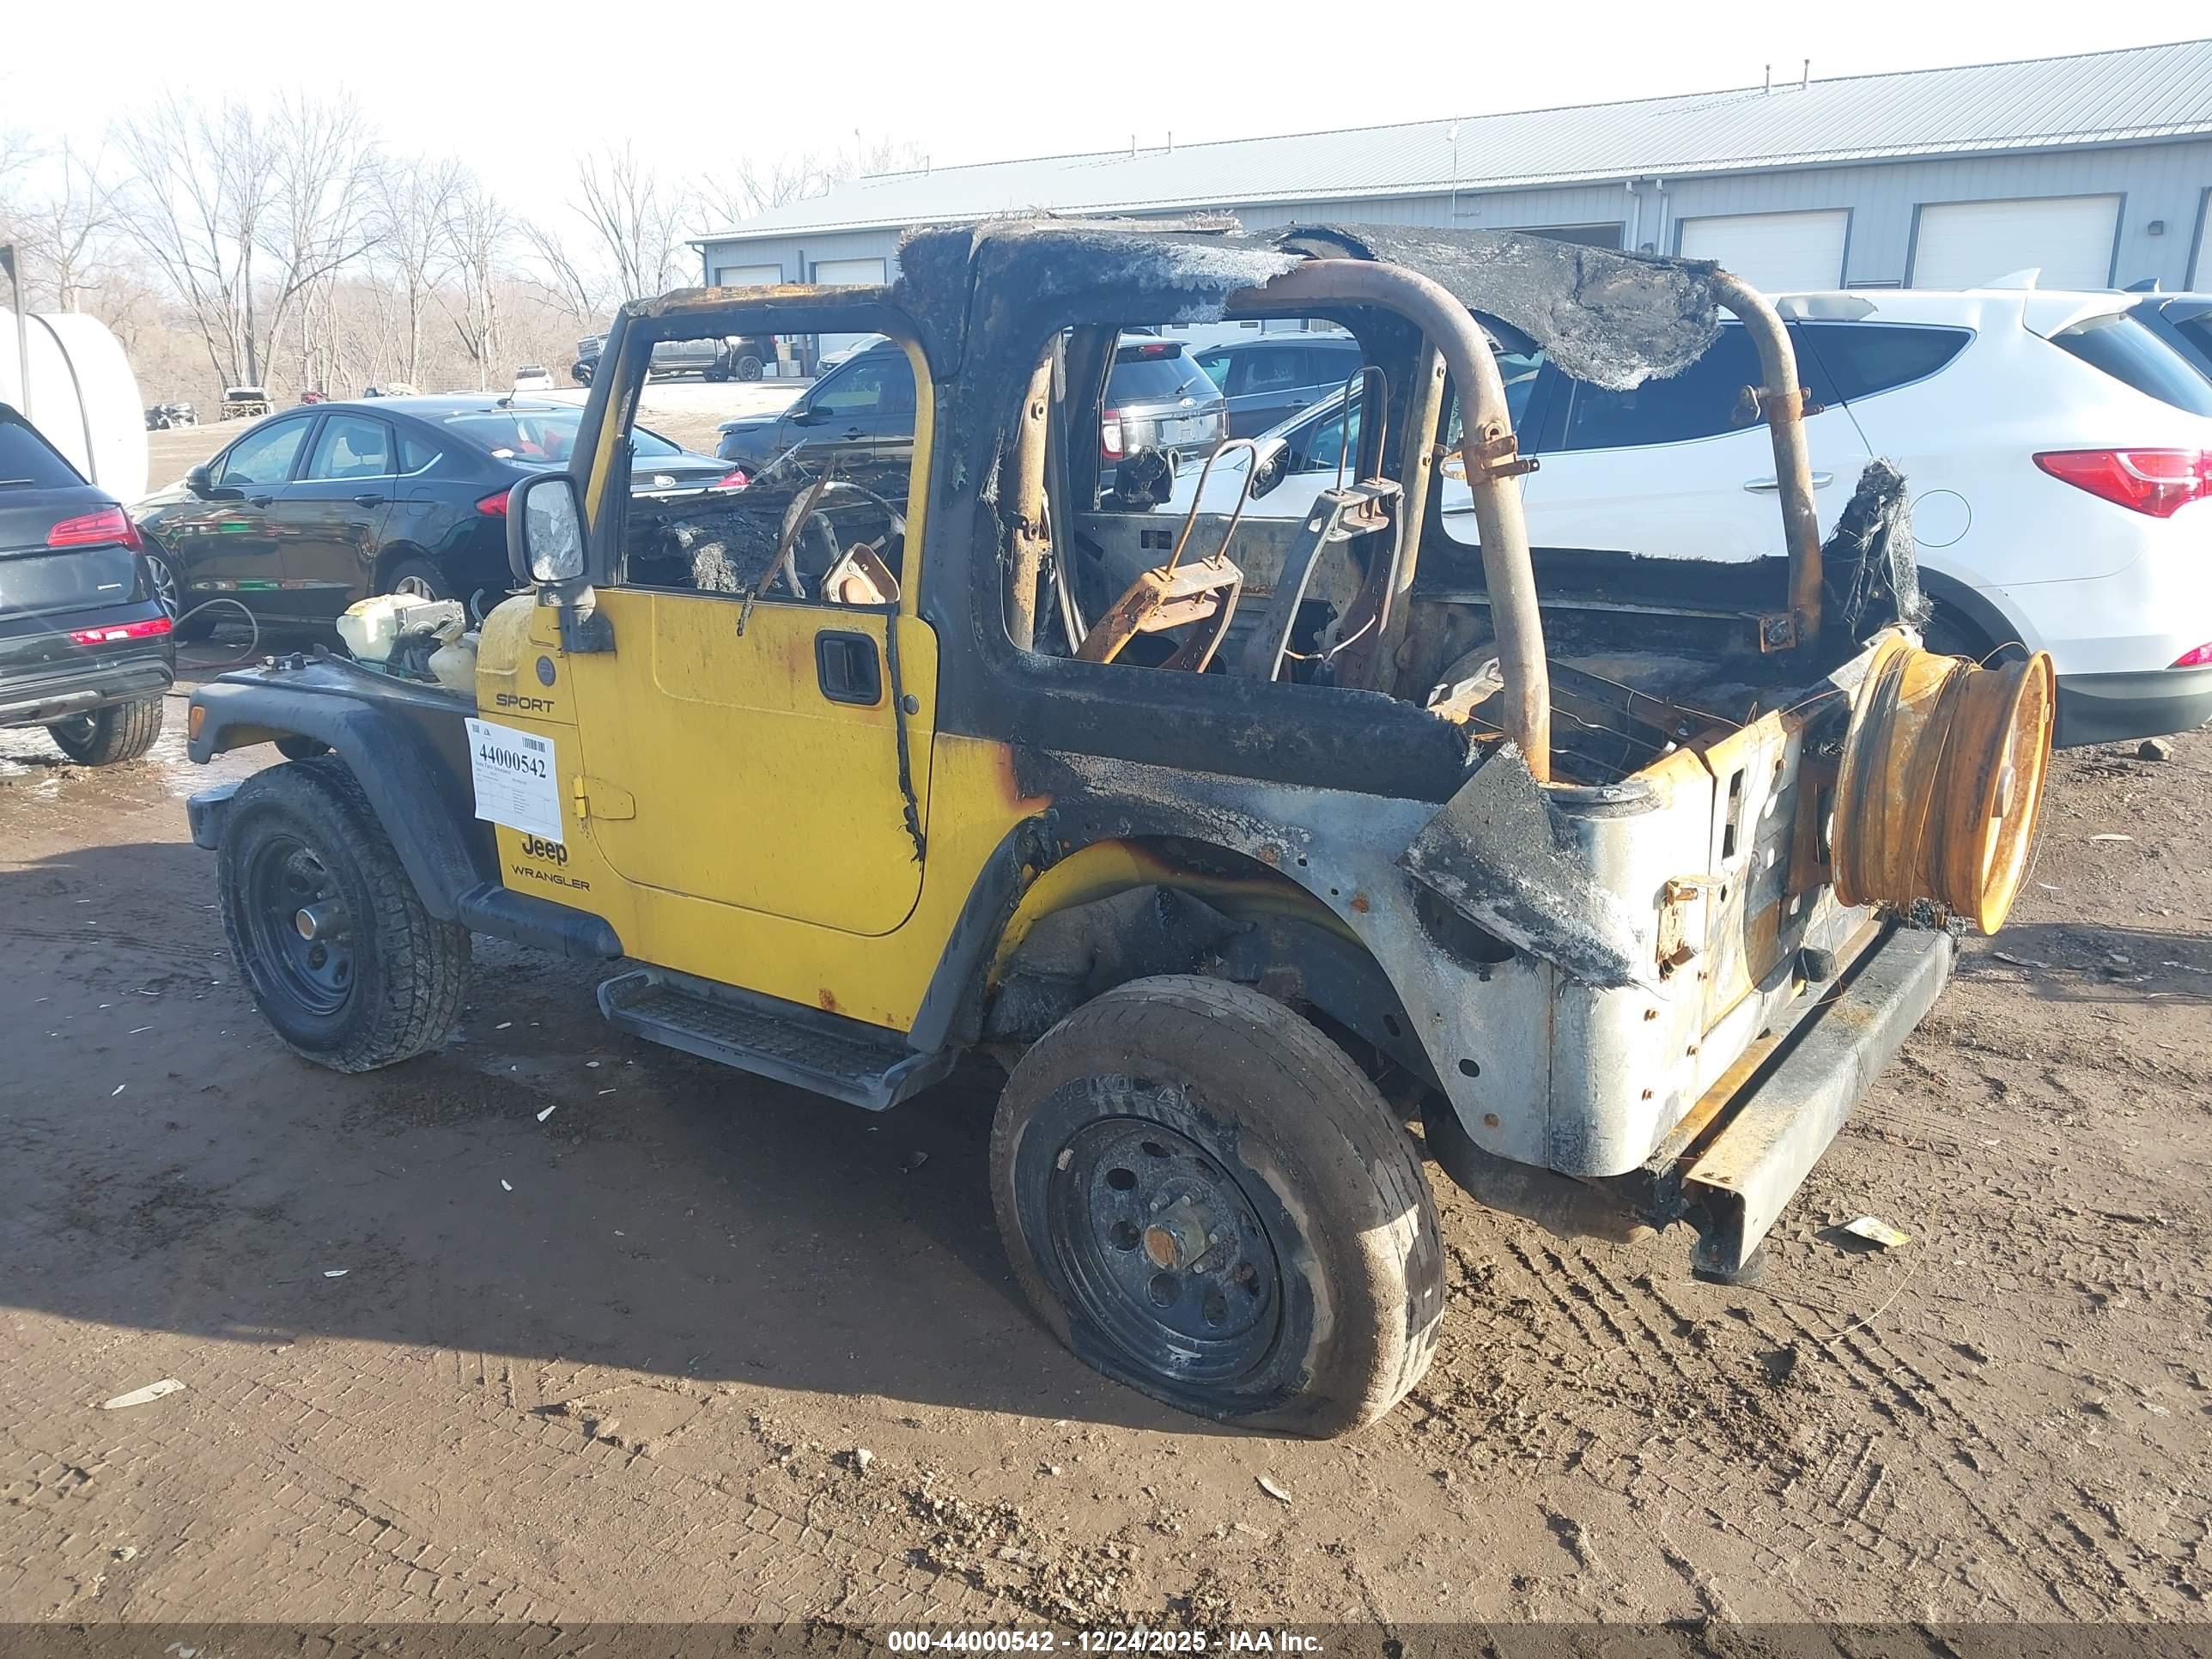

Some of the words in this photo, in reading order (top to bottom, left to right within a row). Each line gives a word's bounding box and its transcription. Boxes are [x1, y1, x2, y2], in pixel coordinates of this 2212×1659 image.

[495, 693, 555, 713] SPORT
[479, 743, 546, 779] 44000542
[521, 833, 568, 866] Jeep
[511, 864, 591, 892] WRANGLER
